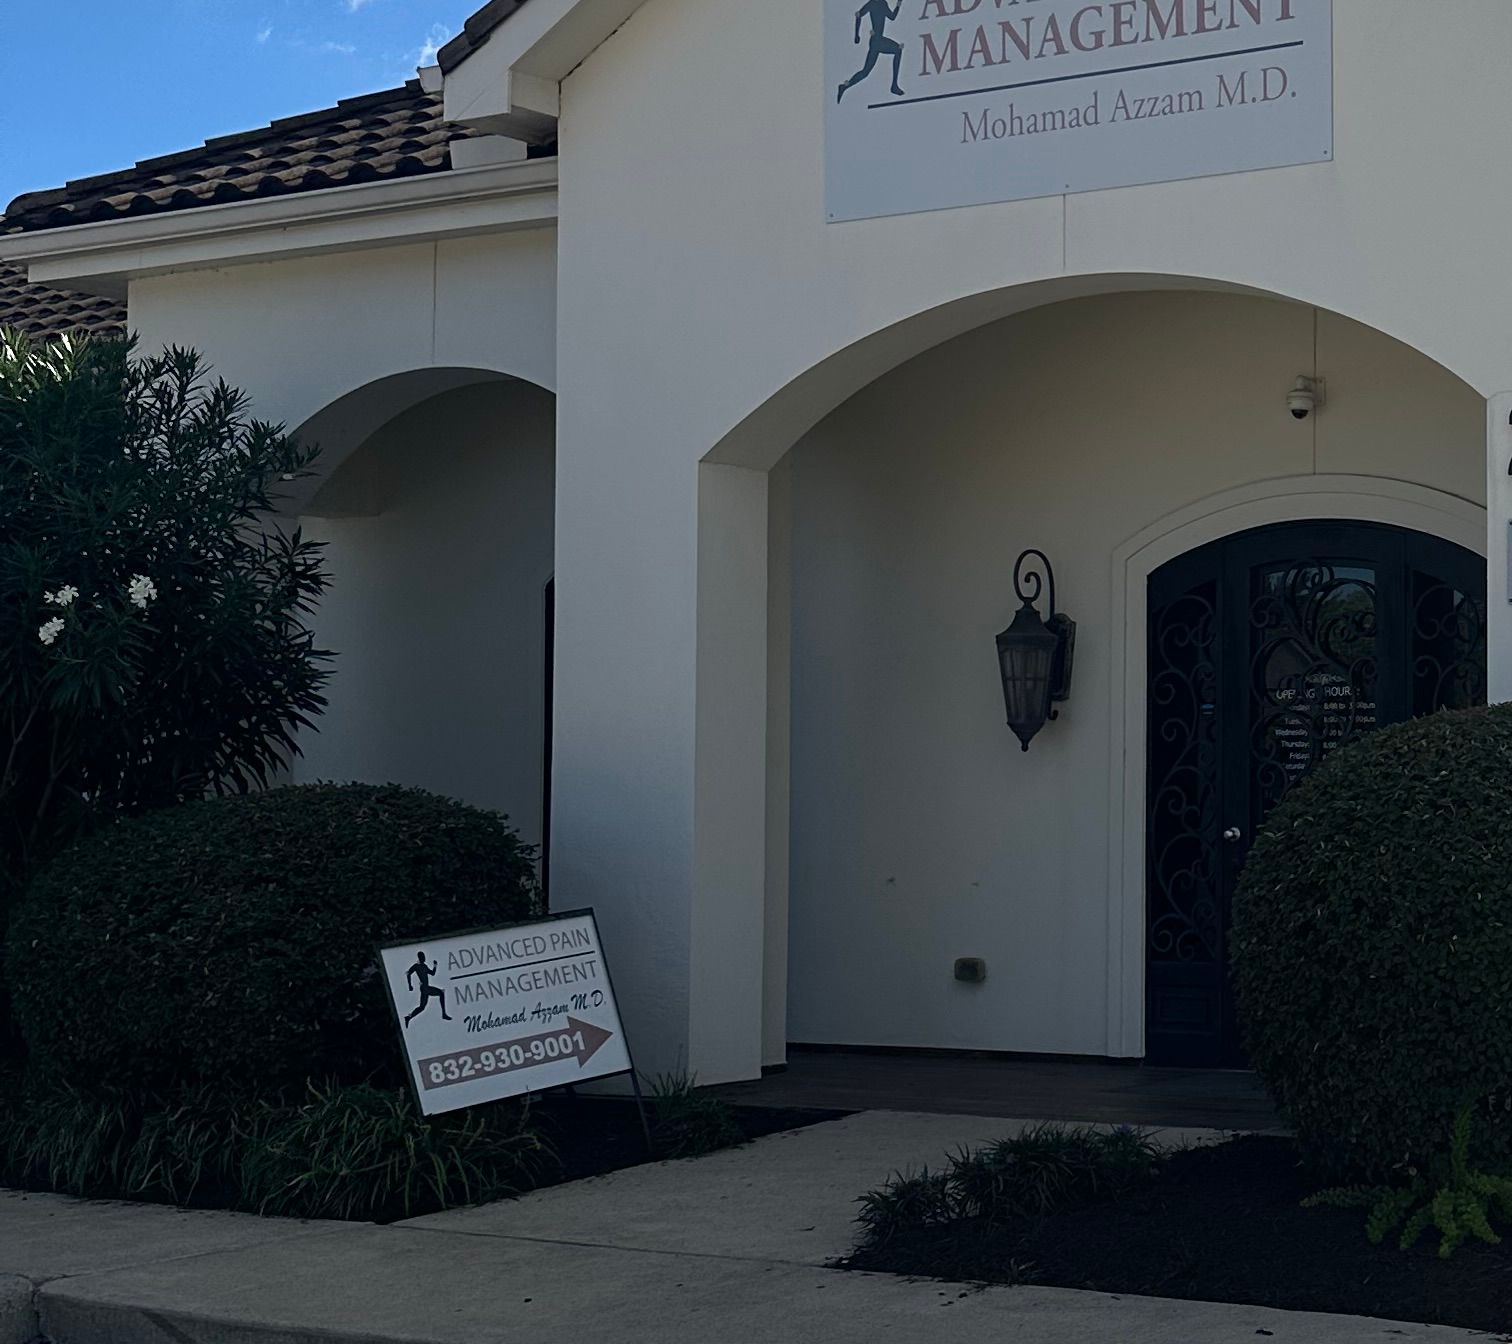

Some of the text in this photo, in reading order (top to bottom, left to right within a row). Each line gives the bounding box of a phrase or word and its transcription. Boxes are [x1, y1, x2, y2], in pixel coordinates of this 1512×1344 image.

[960, 66, 1298, 144] Mohamad Azzam M.D.
[448, 928, 591, 970] ADVANCED PAIN
[454, 960, 597, 1005] MANAGEMENT
[464, 1007, 527, 1033] Mohamad
[530, 1002, 569, 1024] Azzam
[428, 1031, 586, 1084] 832-930-9001
